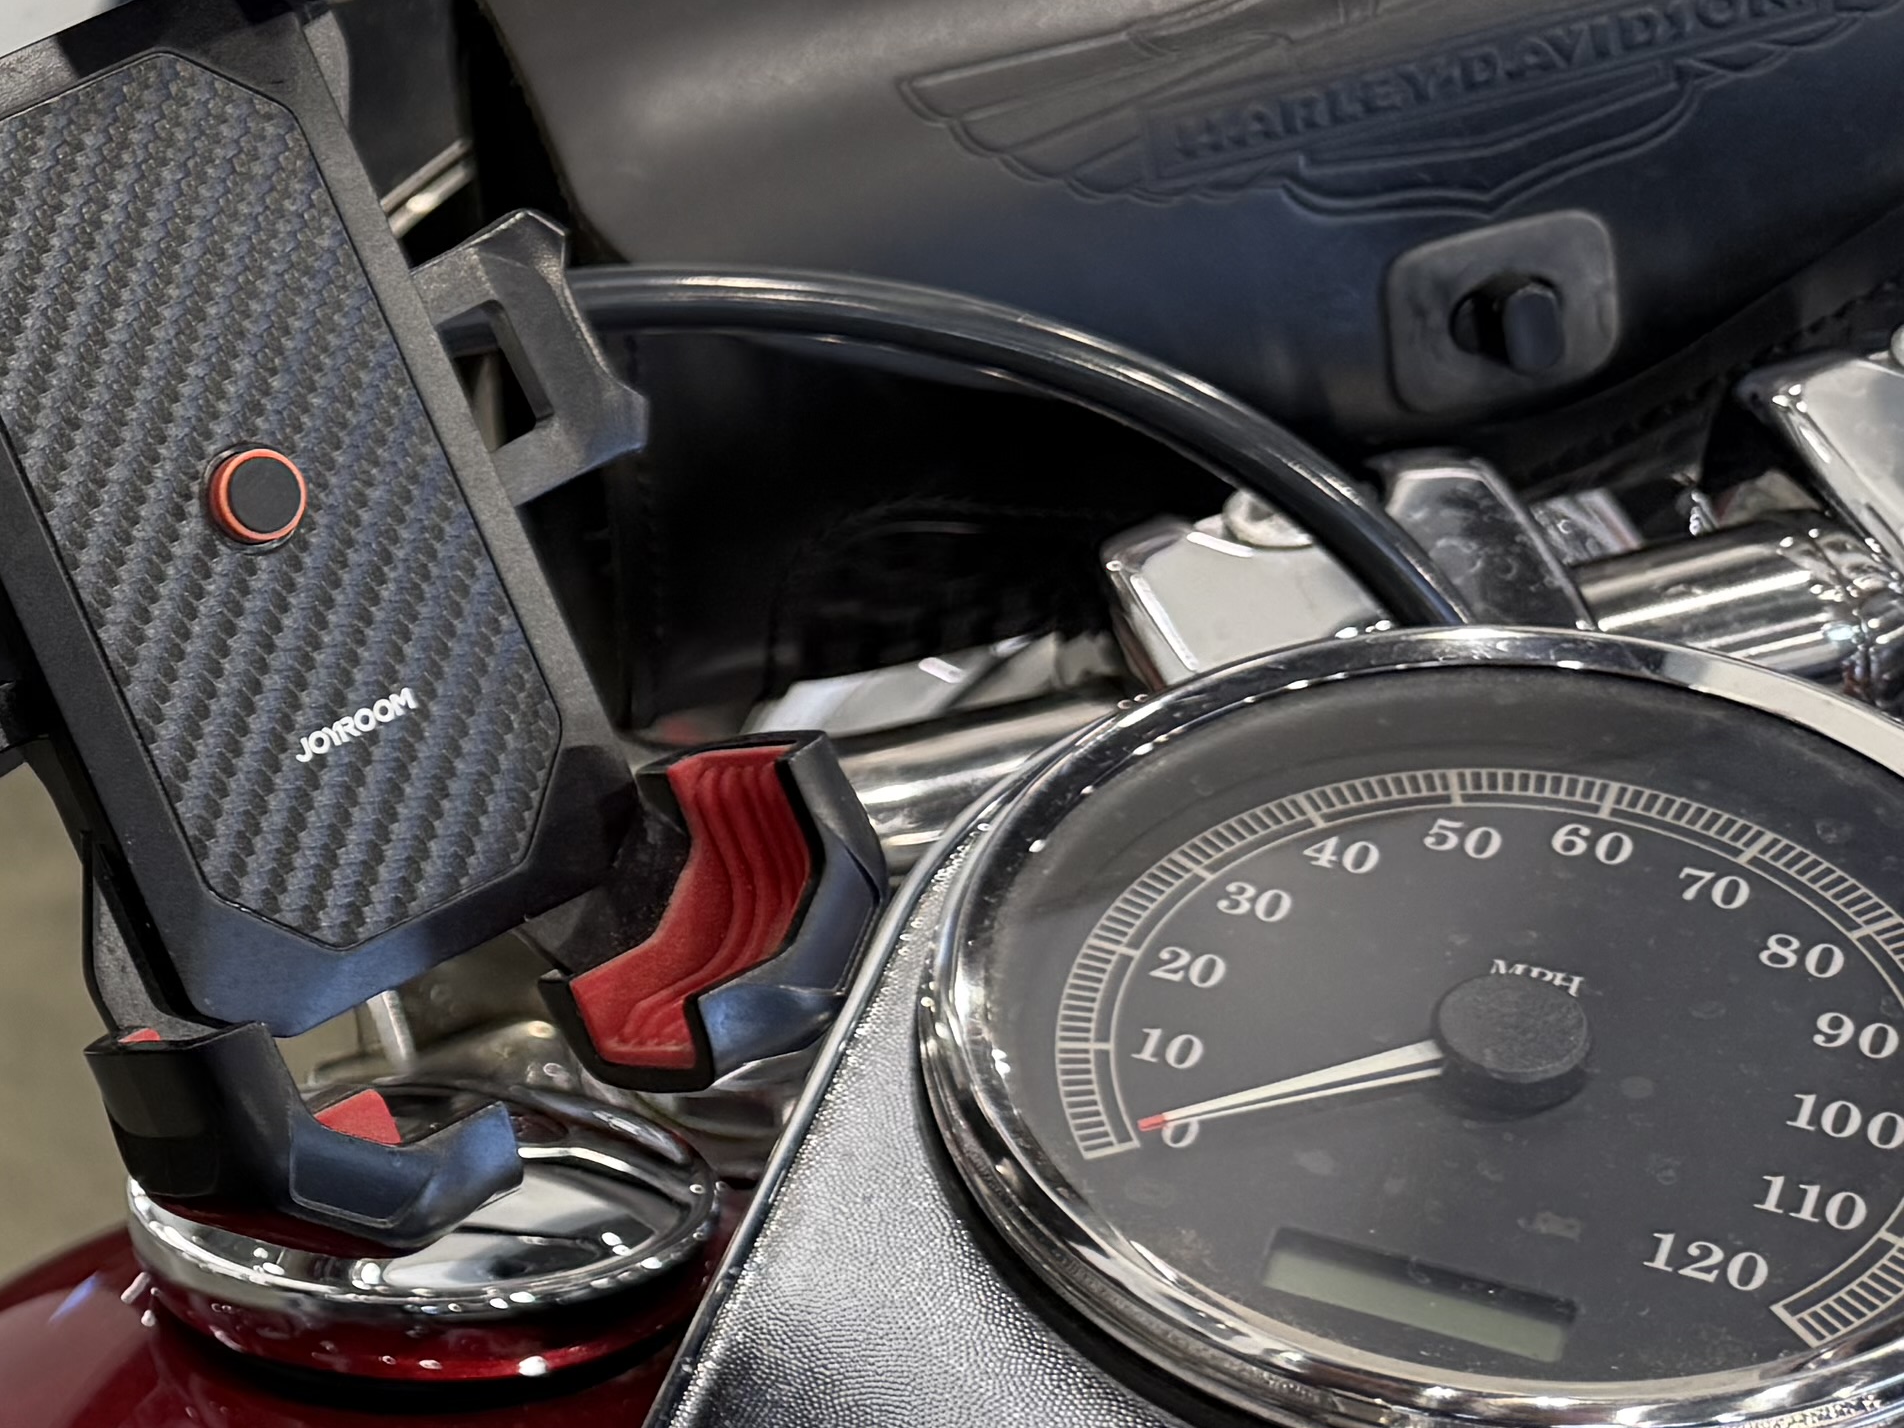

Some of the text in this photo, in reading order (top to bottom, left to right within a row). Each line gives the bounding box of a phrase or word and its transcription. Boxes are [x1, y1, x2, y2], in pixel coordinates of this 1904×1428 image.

[294, 686, 419, 764] JOYROOM
[1302, 835, 1381, 876] 40
[1422, 817, 1503, 861] 50
[1549, 826, 1635, 867] 60
[1215, 880, 1294, 925] 30
[1677, 865, 1752, 911] 70
[1148, 945, 1229, 990] 20
[1757, 932, 1846, 979] 80
[1130, 1027, 1205, 1070] 10
[1811, 1011, 1900, 1060] 90
[1785, 1092, 1904, 1151] 100
[1752, 1174, 1868, 1231] 110
[1642, 1231, 1770, 1292] 120
